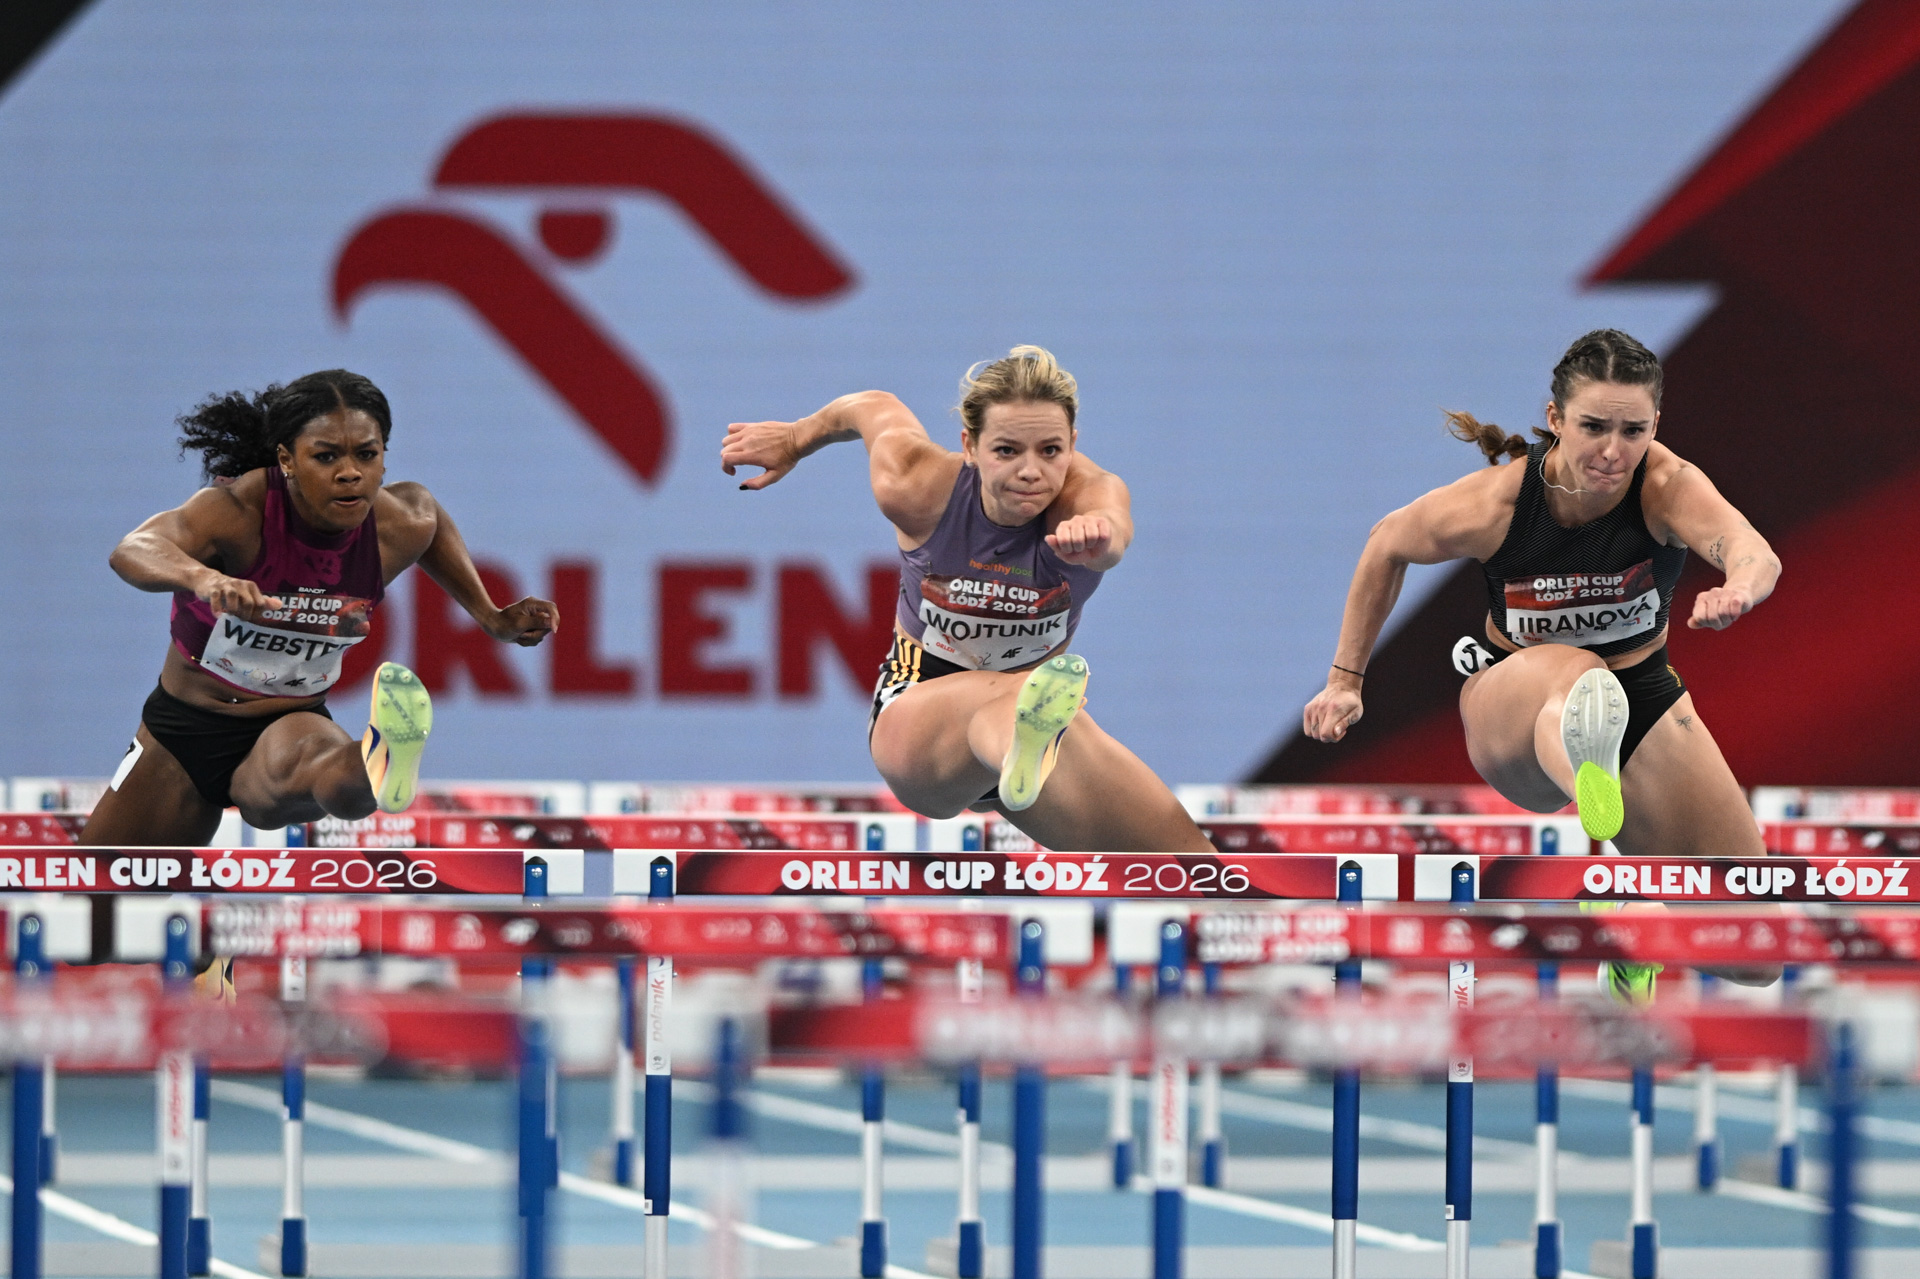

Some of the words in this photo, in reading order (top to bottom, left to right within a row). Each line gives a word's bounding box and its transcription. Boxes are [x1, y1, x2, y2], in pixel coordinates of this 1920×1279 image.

[298, 586, 327, 595] BANDIT
[950, 578, 1005, 597] ORLEN
[1008, 586, 1040, 603] CUP
[1533, 575, 1589, 591] ORLEN
[1592, 575, 1624, 587] CUP
[949, 593, 988, 609] ŁÓDŹ
[993, 601, 1039, 615] 2026
[1535, 588, 1575, 602] ŁÓDŹ
[1579, 587, 1625, 598] 2026
[312, 597, 343, 612] CUP
[296, 613, 340, 626] 2026
[926, 608, 1062, 641] WOJTUNIK
[935, 641, 956, 654] ORLEN
[109, 857, 182, 887] CUP
[191, 851, 296, 888] ŁÓDŹ
[310, 859, 438, 889] 2026
[781, 860, 910, 890] ORLEN
[924, 860, 996, 891] CUP
[1003, 854, 1109, 891] ŁÓDŹ
[1124, 862, 1251, 893] 2026
[1583, 865, 1711, 894] ORLEN
[1725, 865, 1796, 896] CUP
[1805, 859, 1909, 897] ŁÓDŹ
